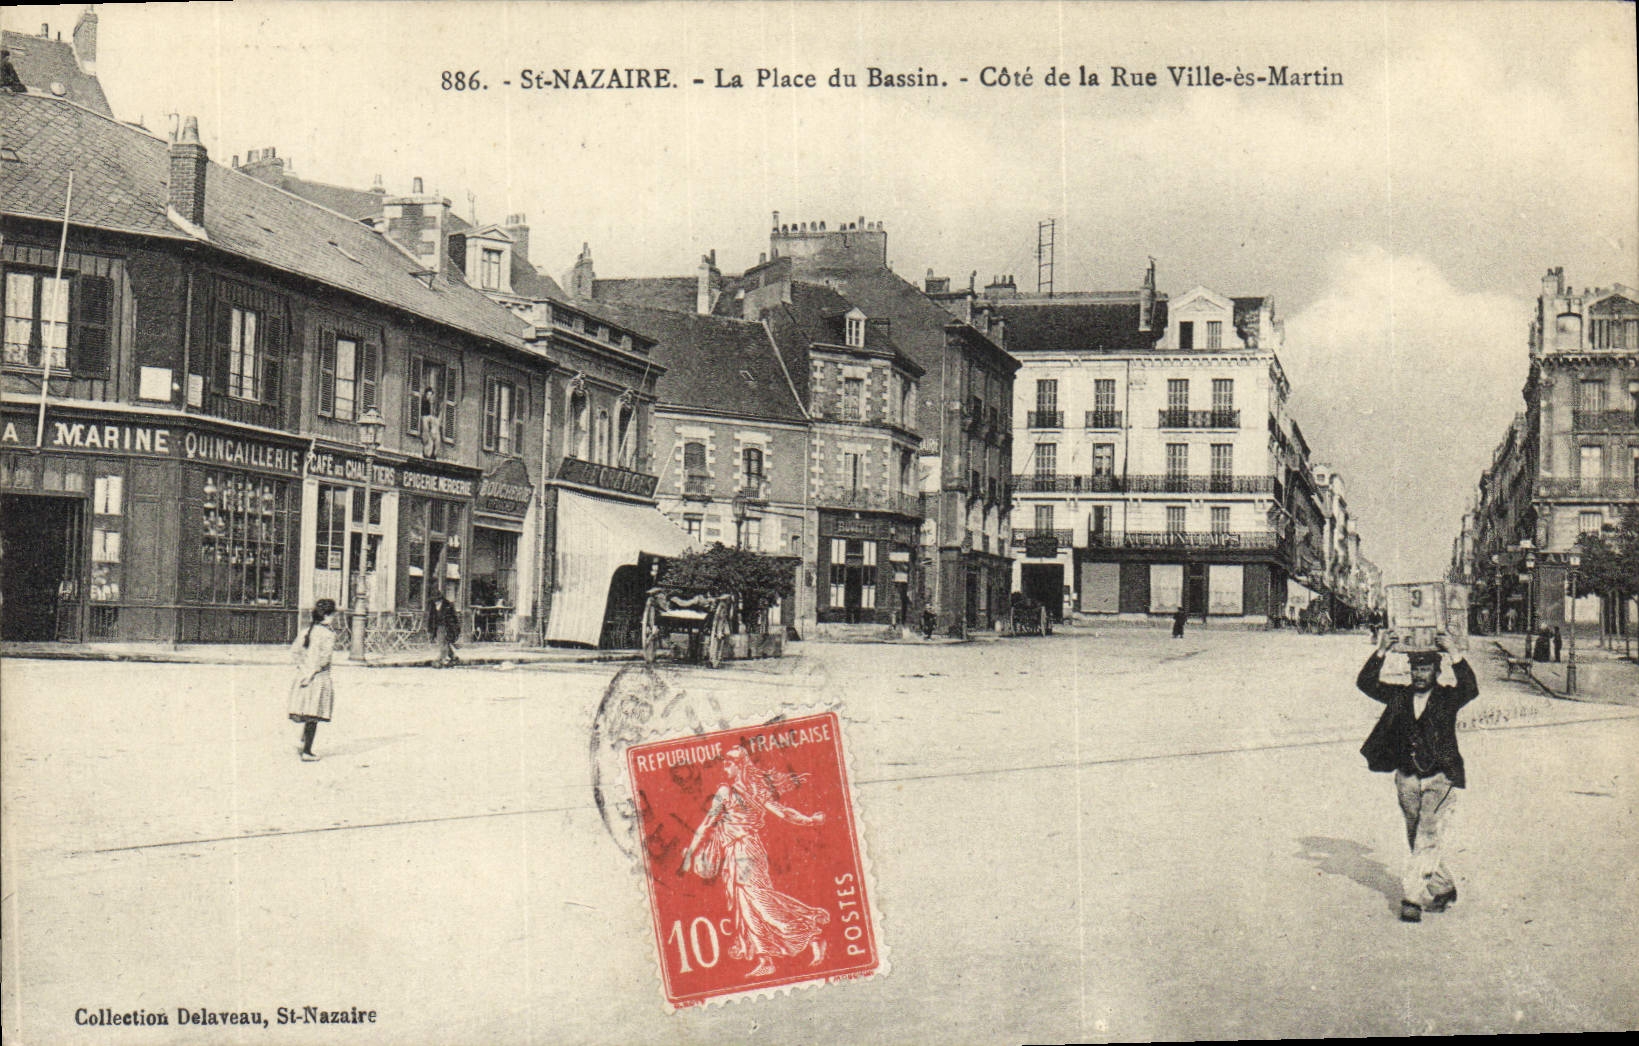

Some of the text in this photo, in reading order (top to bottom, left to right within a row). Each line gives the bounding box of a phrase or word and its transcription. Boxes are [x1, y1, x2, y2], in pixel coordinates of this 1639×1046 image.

[53, 422, 170, 454] MARINE
[185, 431, 299, 473] QUINCAILLERIE
[345, 459, 395, 486] CHALTIERS
[636, 723, 832, 773] REPUBLIQUE FRANÇAISE
[834, 872, 866, 956] POSTES
